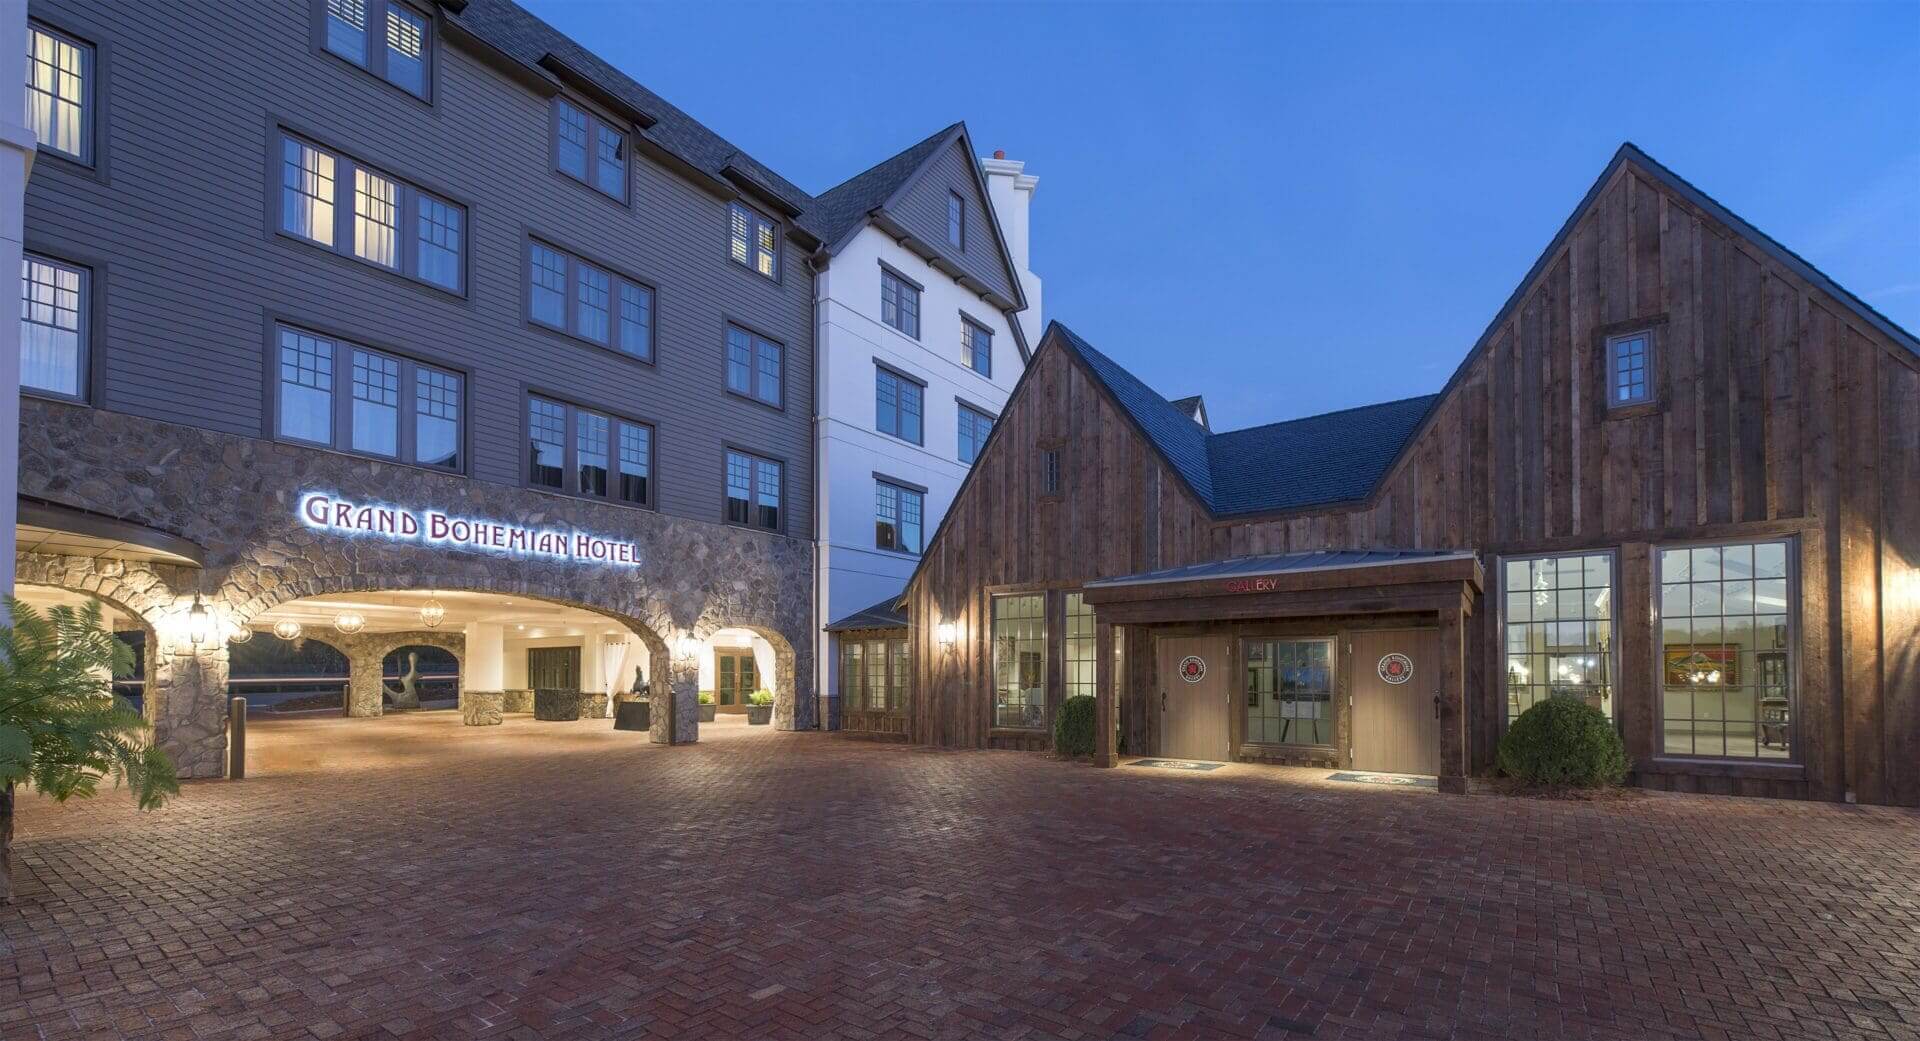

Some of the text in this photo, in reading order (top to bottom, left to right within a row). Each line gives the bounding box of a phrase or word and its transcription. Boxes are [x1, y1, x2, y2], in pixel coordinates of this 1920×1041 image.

[305, 496, 641, 564] GRAND BOHEMIAN HOTEL
[1227, 579, 1277, 591] GALLERY
